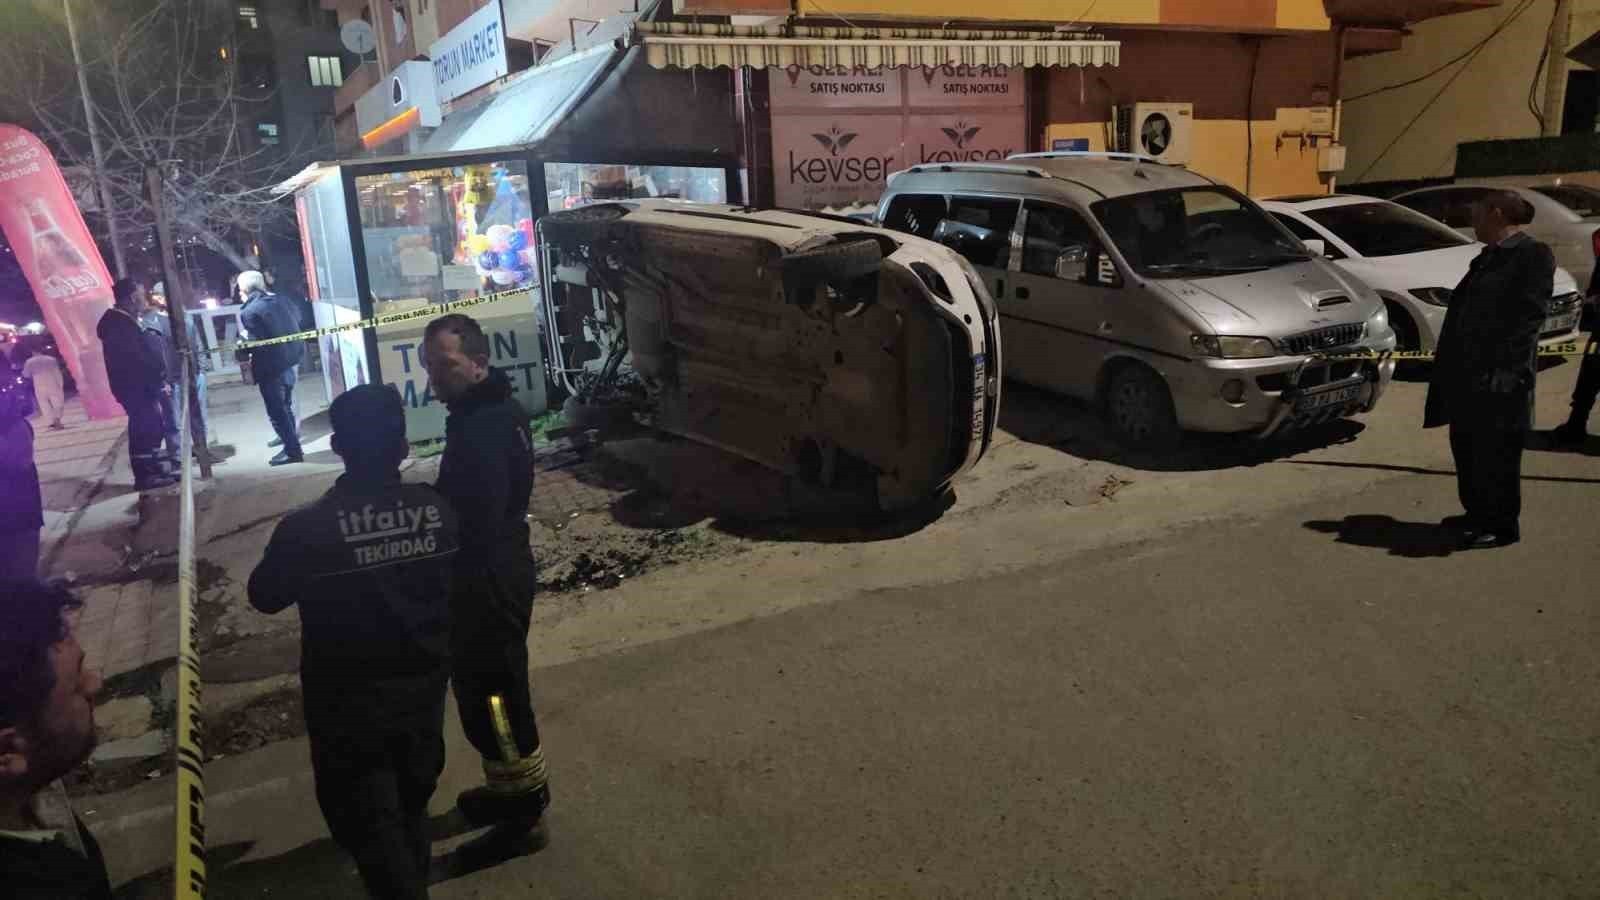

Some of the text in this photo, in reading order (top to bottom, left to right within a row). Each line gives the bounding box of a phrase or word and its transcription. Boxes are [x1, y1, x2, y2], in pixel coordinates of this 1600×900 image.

[433, 22, 500, 86] TORUN MARKET
[810, 83, 885, 95] SATIŞ NOKTASI
[943, 84, 968, 95] SATIŞ
[789, 150, 894, 184] kevser
[337, 501, 441, 535] itfaiye
[354, 530, 437, 565] TEKİRDAĞ
